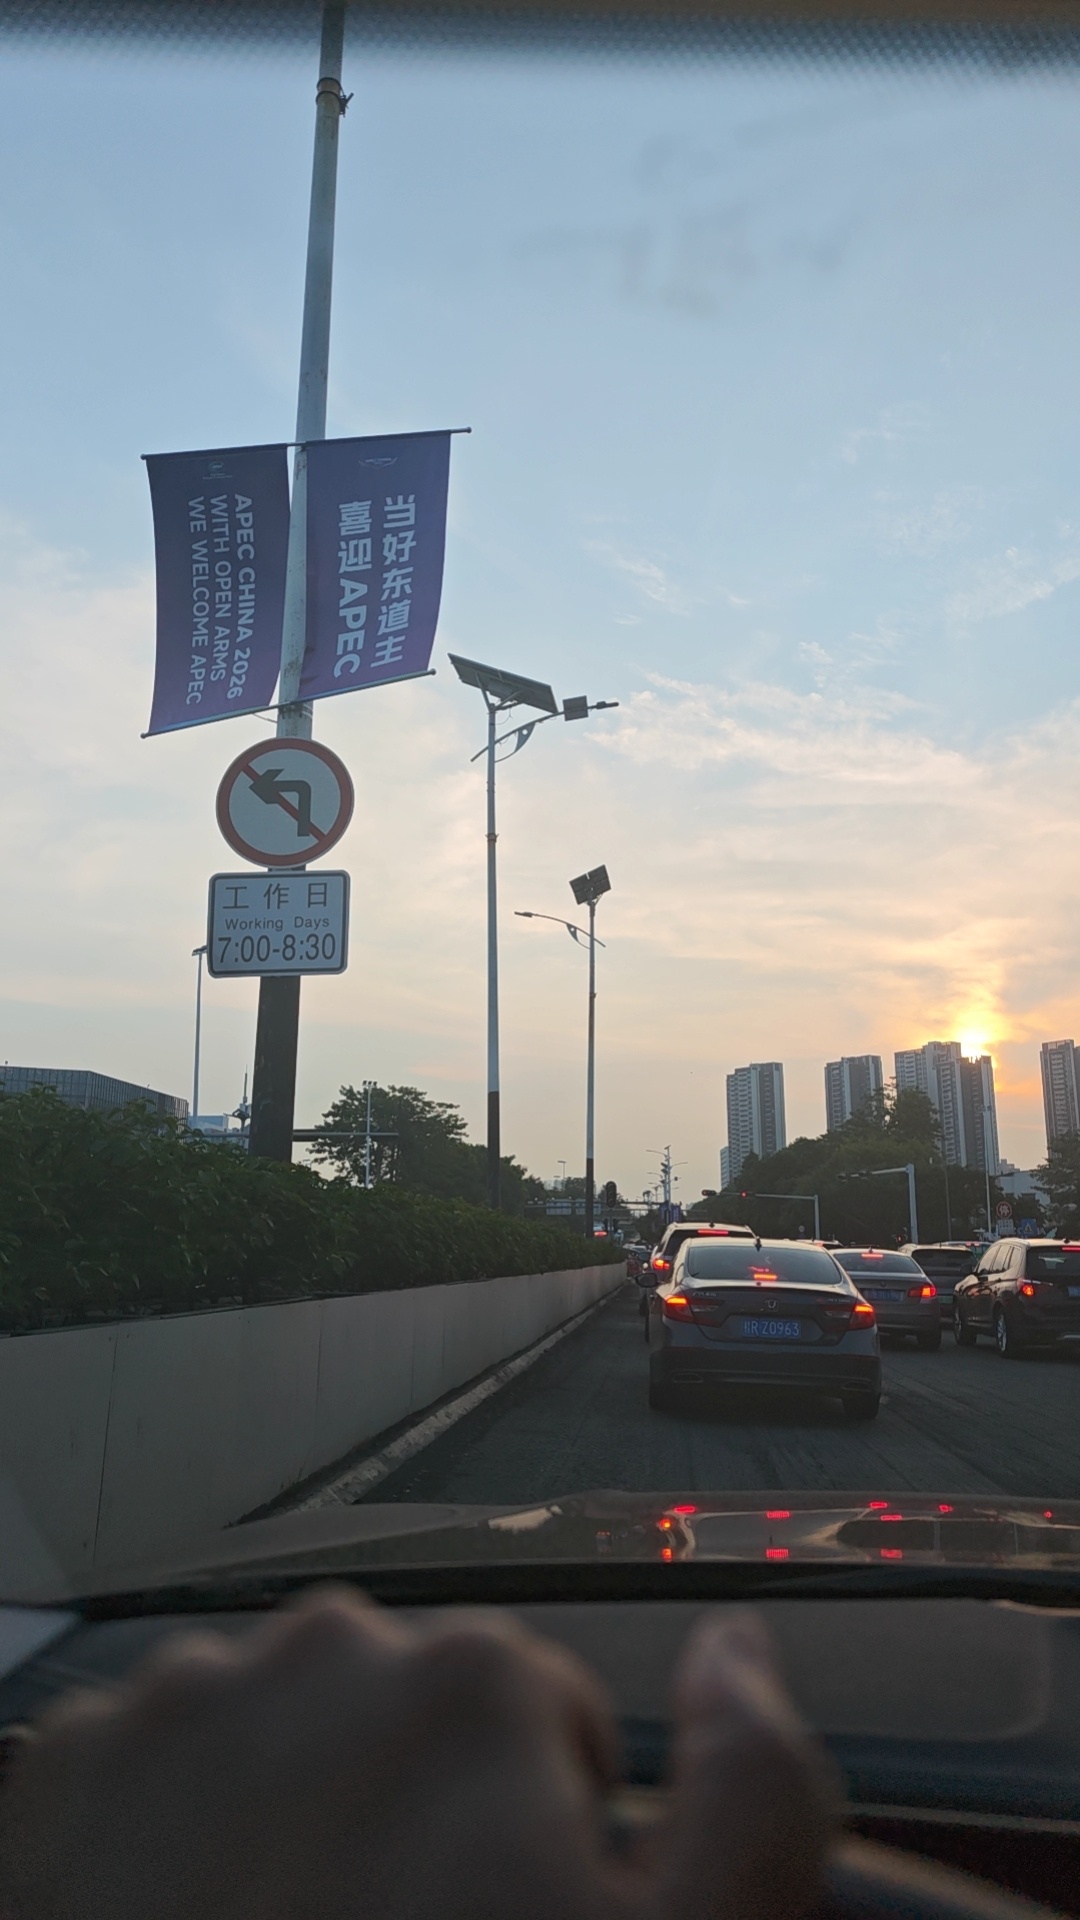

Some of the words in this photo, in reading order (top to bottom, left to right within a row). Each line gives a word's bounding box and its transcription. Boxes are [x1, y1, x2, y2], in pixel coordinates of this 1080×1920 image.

[187, 496, 207, 533] WE
[210, 495, 230, 553] WITH
[235, 493, 255, 560] APEC
[191, 541, 210, 648] WELCOME
[214, 563, 232, 618] OPEN
[235, 566, 256, 643] CHINA
[370, 493, 417, 668] 当好东道主
[185, 654, 206, 705] APEC
[210, 626, 230, 682] ARMS
[227, 648, 251, 699] 2026
[222, 882, 328, 910] 工作日
[224, 917, 284, 932] Working
[294, 915, 330, 931] Days
[217, 933, 336, 963] 7:00-8:30
